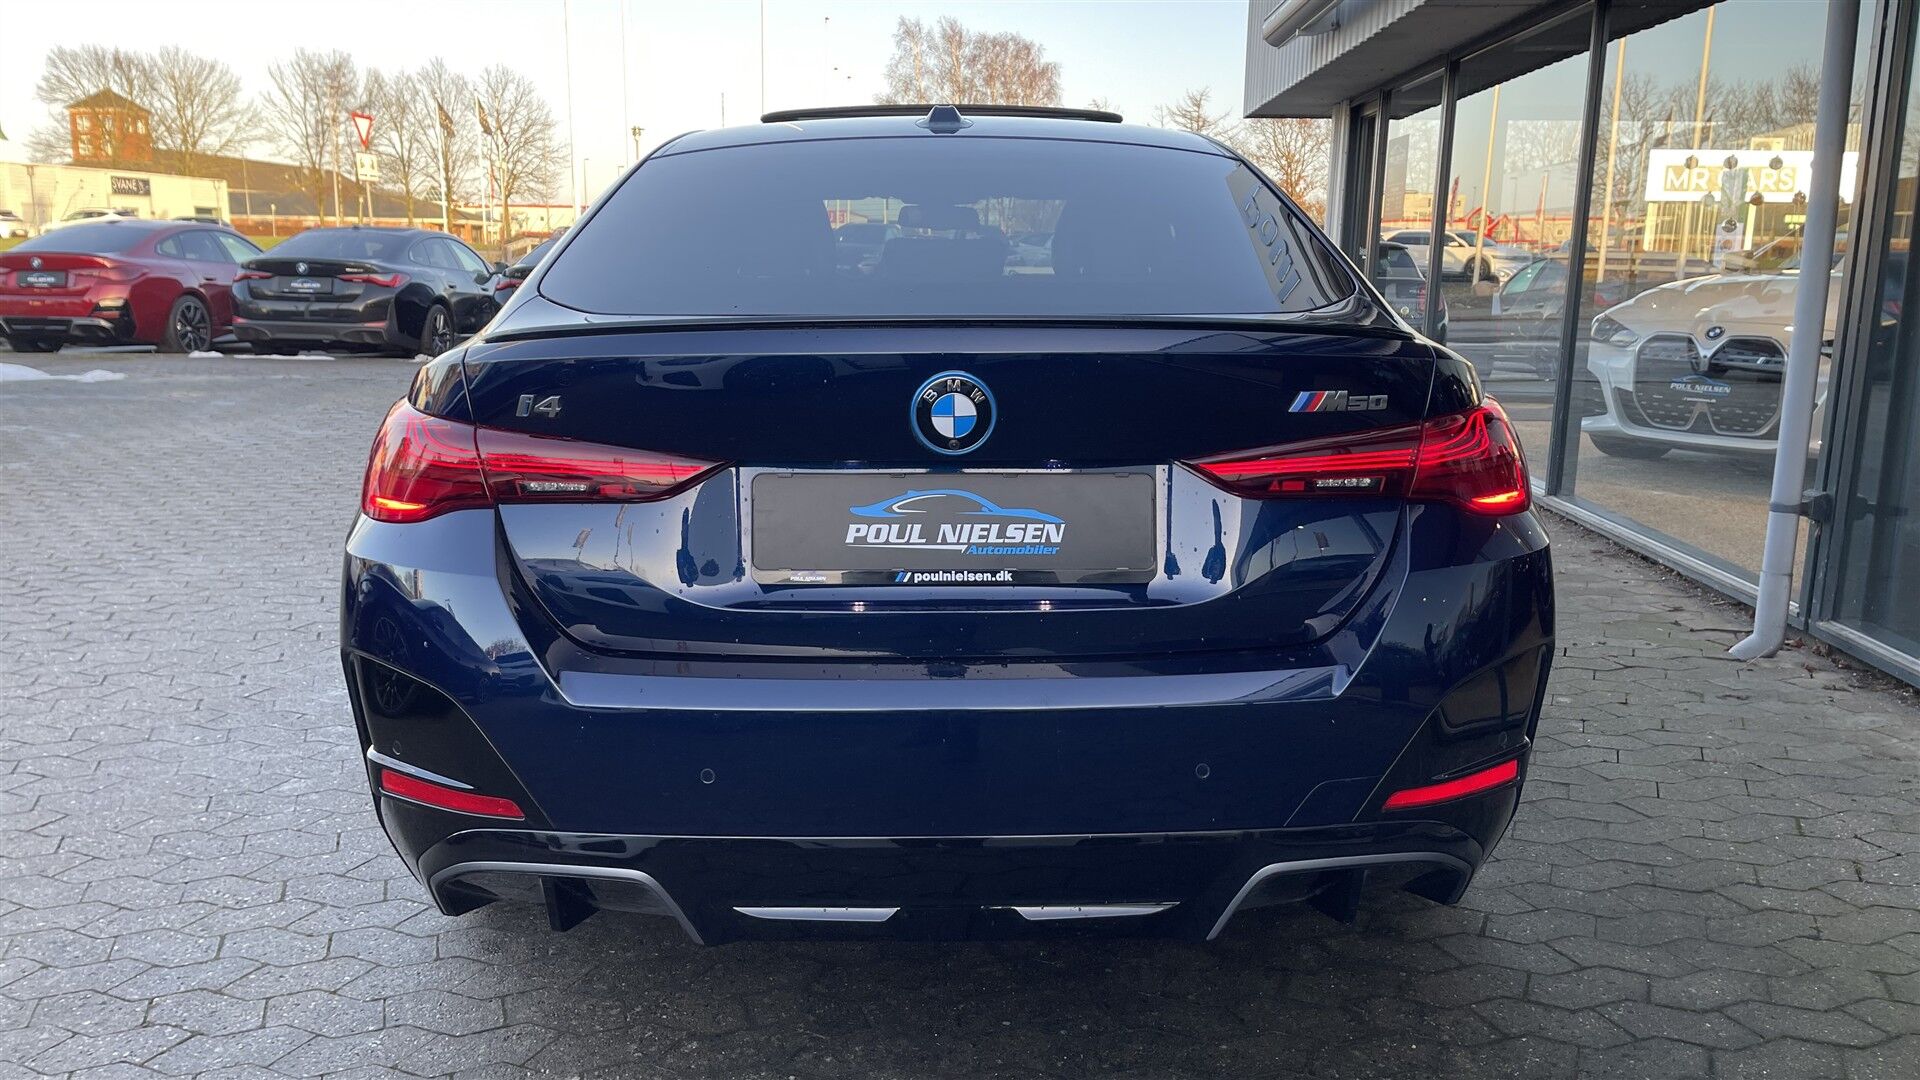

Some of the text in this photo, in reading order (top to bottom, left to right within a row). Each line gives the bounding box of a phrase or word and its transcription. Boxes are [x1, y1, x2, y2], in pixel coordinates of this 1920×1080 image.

[112, 177, 137, 192] SVANE
[1665, 167, 1794, 191] MR ARS
[923, 379, 986, 404] BMW
[1317, 391, 1388, 412] M50
[515, 394, 562, 418] i4
[845, 523, 1066, 544] POUL NIELSEN
[967, 544, 1060, 556] Automobiler
[913, 570, 1013, 584] poulnielsen.dk
